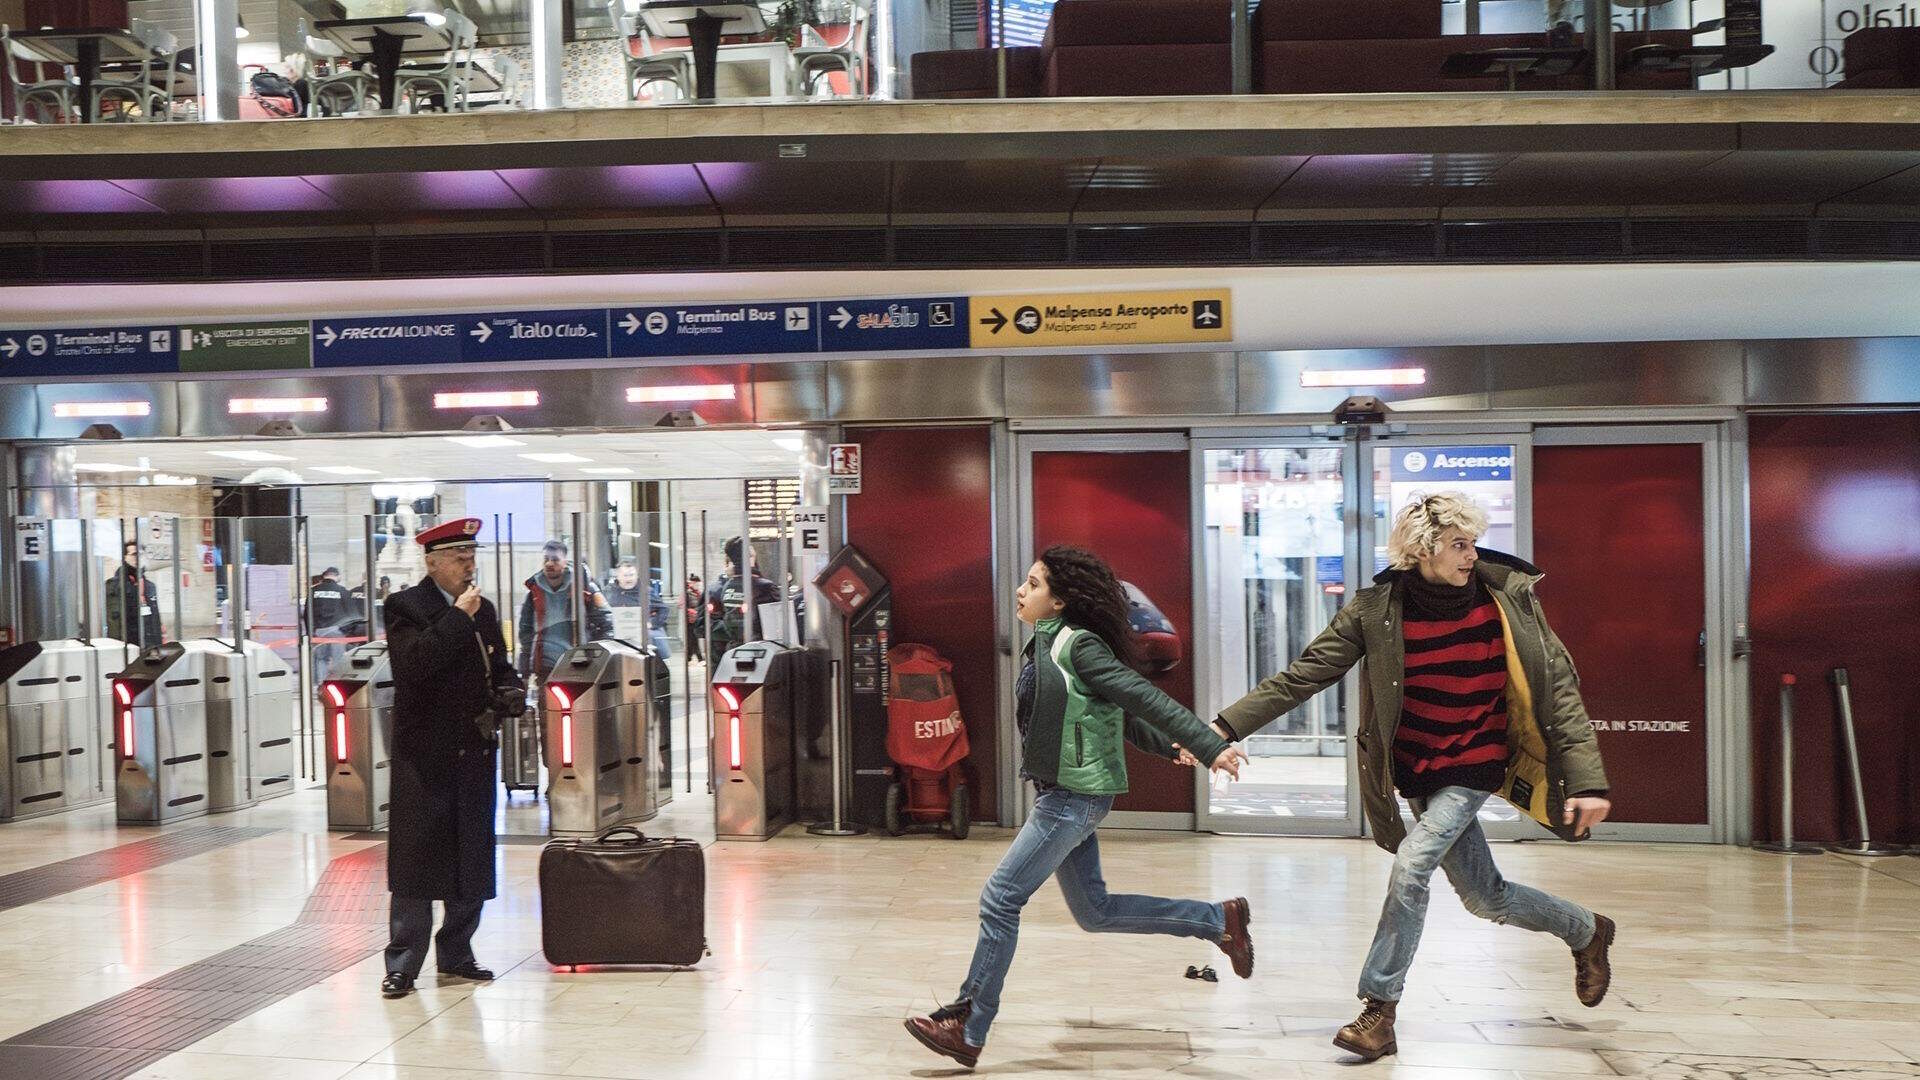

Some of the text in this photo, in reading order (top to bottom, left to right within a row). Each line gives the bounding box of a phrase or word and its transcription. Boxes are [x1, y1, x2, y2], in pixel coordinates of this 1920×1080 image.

[676, 308, 777, 324] Terminal Bus
[1045, 303, 1189, 320] Malpensa Aeroporto
[257, 327, 310, 336] EMERGENZA
[555, 323, 588, 338] Club
[676, 325, 723, 336] Malpensa
[1045, 321, 1137, 333] Malpensa Airport
[55, 331, 143, 346] Terminal Bus
[794, 513, 827, 523] GATE
[24, 536, 40, 555] E
[803, 529, 819, 549] E
[1611, 720, 1626, 731] IN
[1628, 720, 1690, 732] STAZIONE
